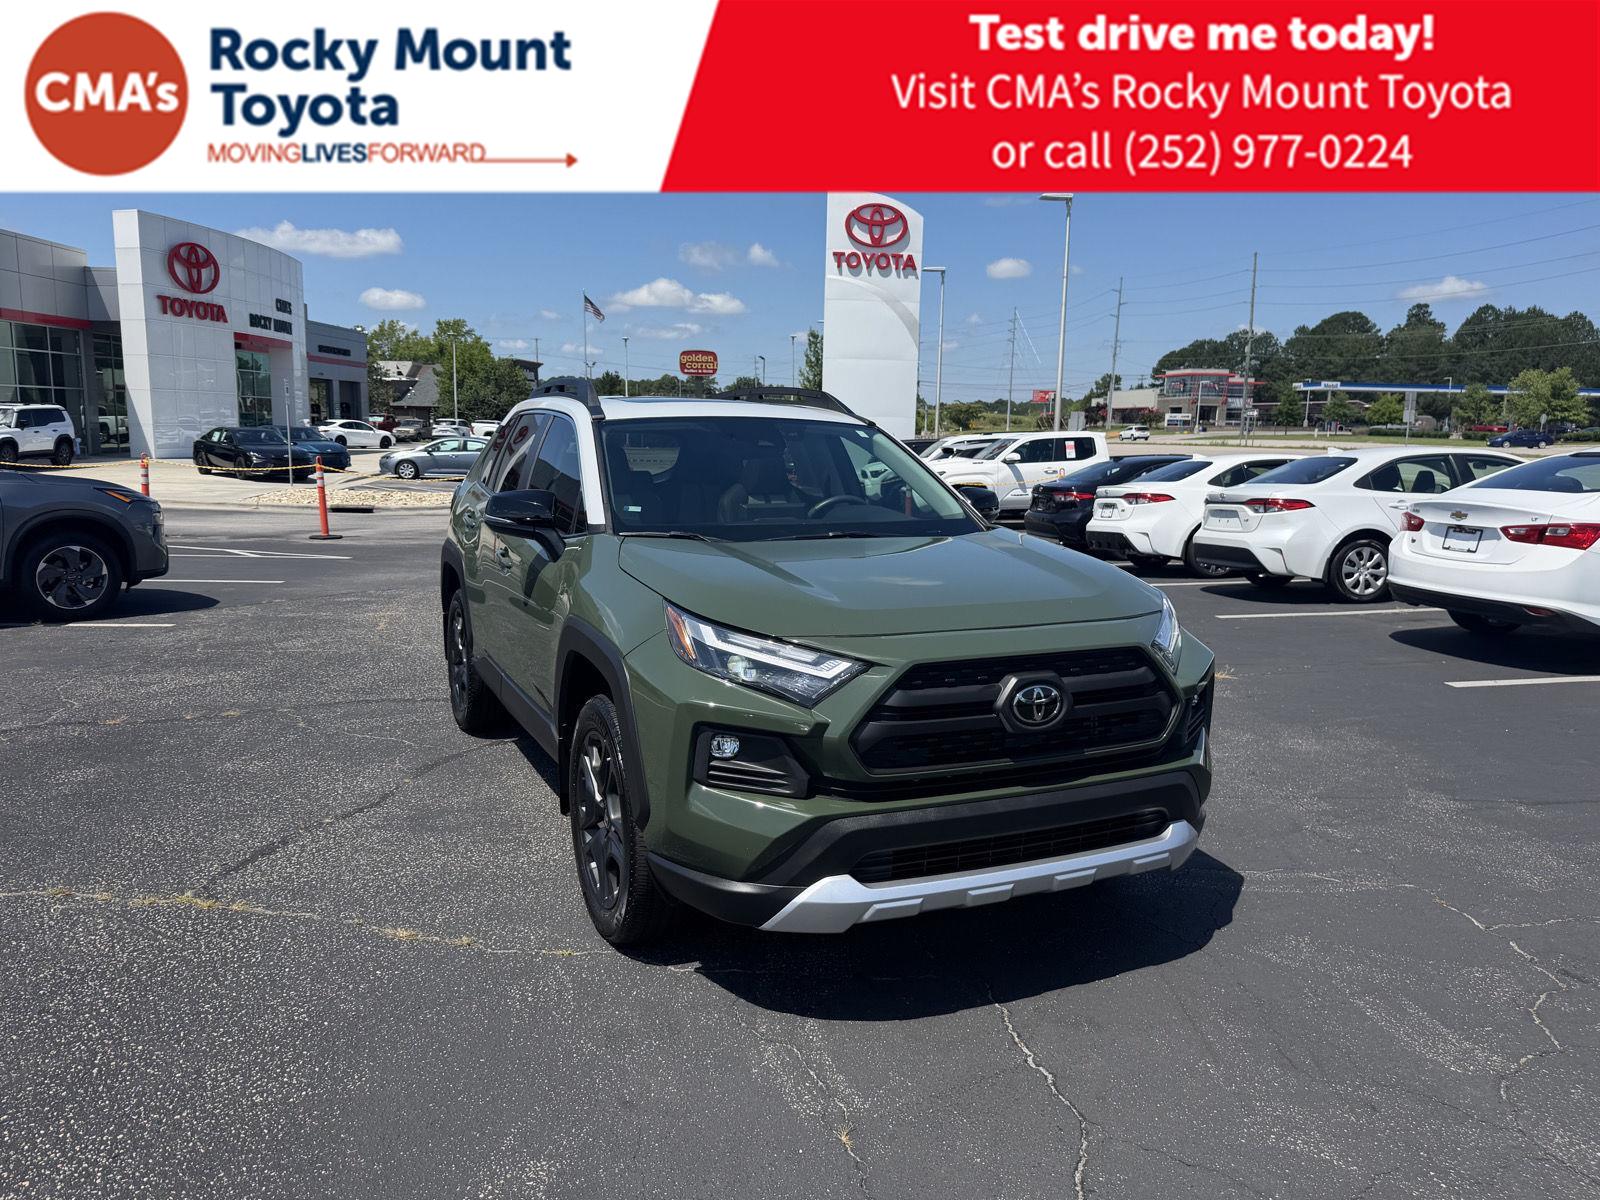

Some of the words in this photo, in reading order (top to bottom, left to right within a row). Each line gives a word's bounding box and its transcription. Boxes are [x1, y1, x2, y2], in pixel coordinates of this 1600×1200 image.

[833, 251, 916, 271] TOYOTA
[156, 295, 228, 323] TOYOTA
[680, 354, 714, 363] golden
[685, 361, 718, 369] corral
